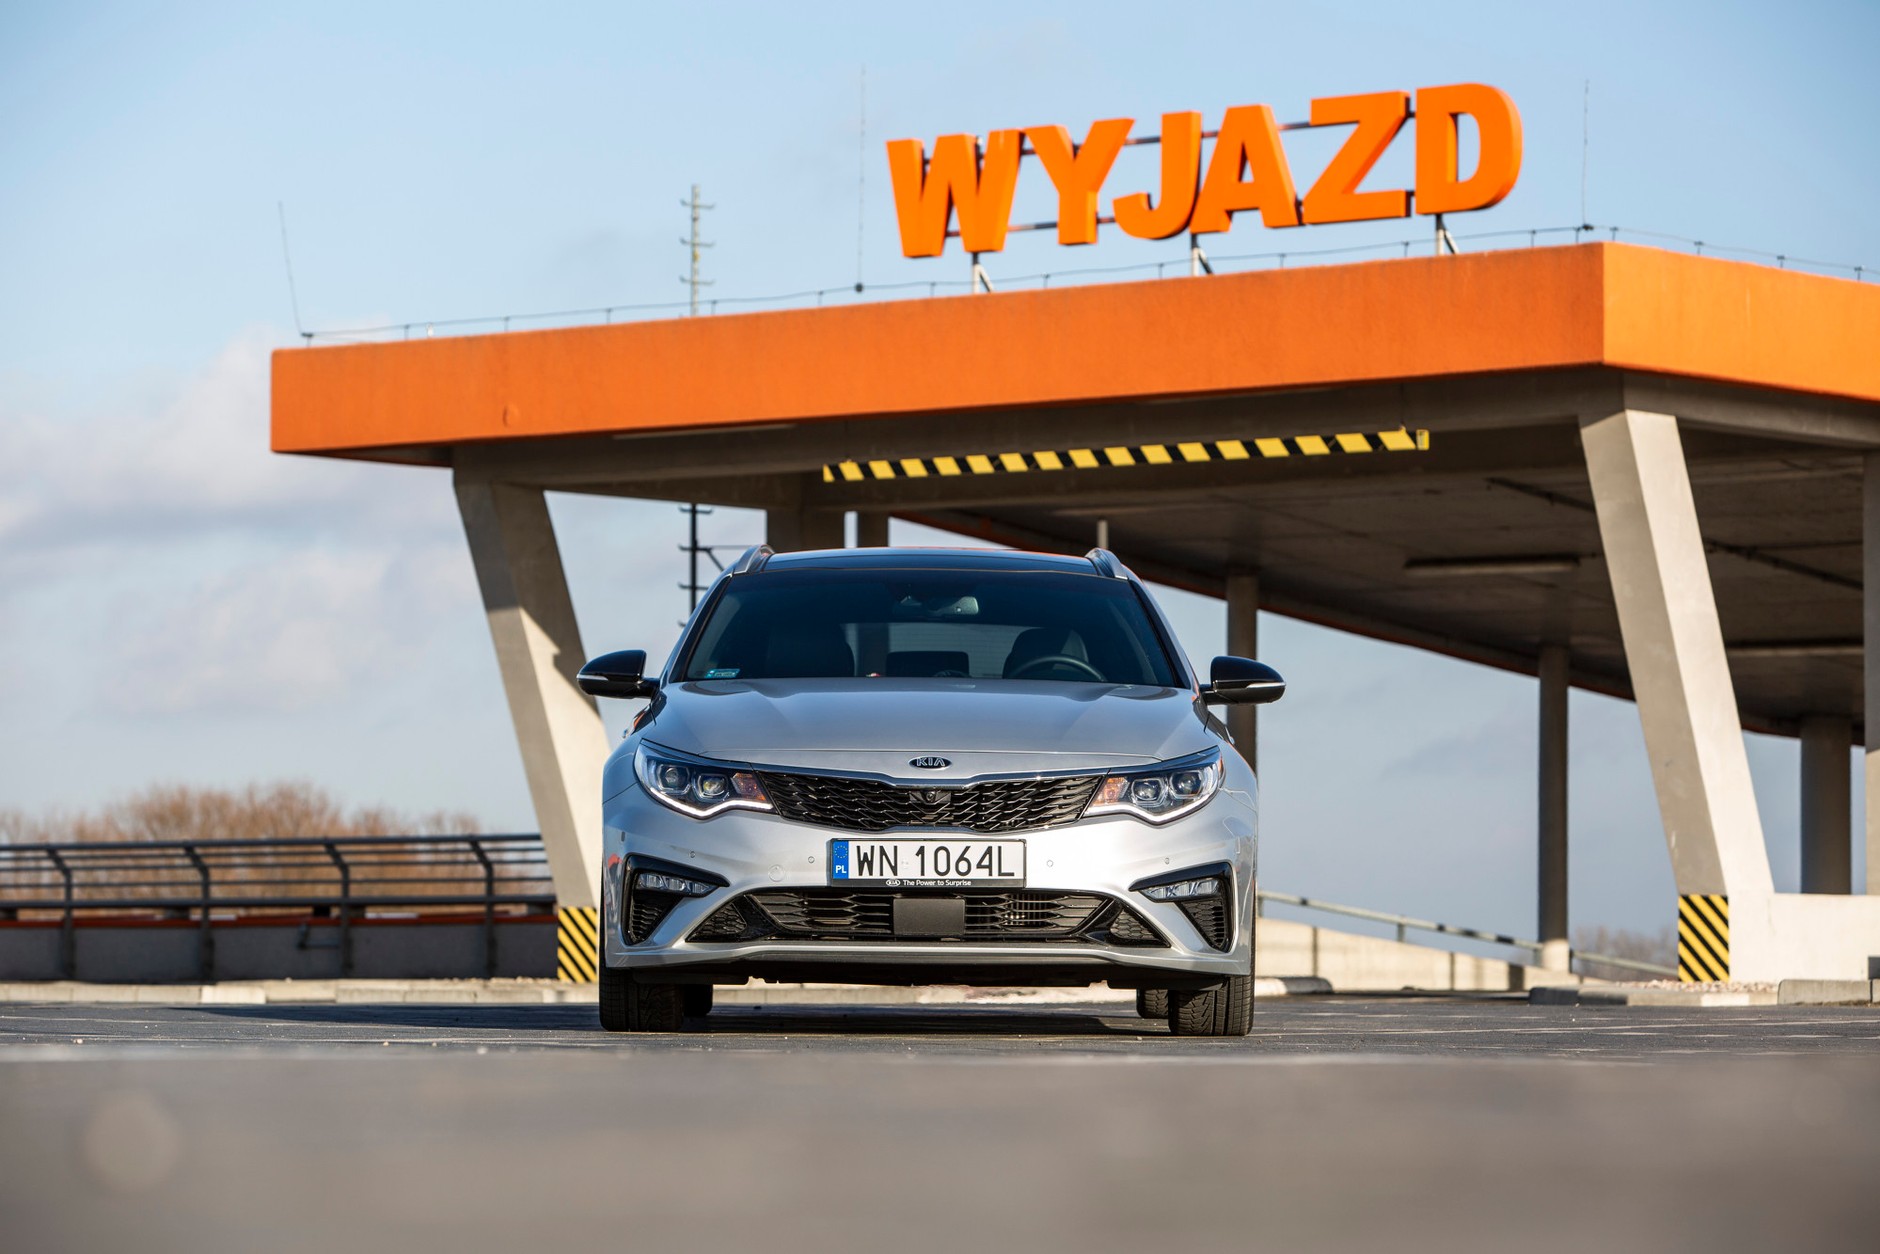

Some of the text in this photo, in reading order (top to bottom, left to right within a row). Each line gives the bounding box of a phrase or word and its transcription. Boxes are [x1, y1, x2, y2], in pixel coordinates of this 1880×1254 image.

[886, 82, 1523, 258] WYJAZD
[916, 757, 945, 766] KIA
[856, 845, 1015, 877] WN 1064L
[835, 864, 847, 874] PL
[945, 879, 972, 887] Surprise
